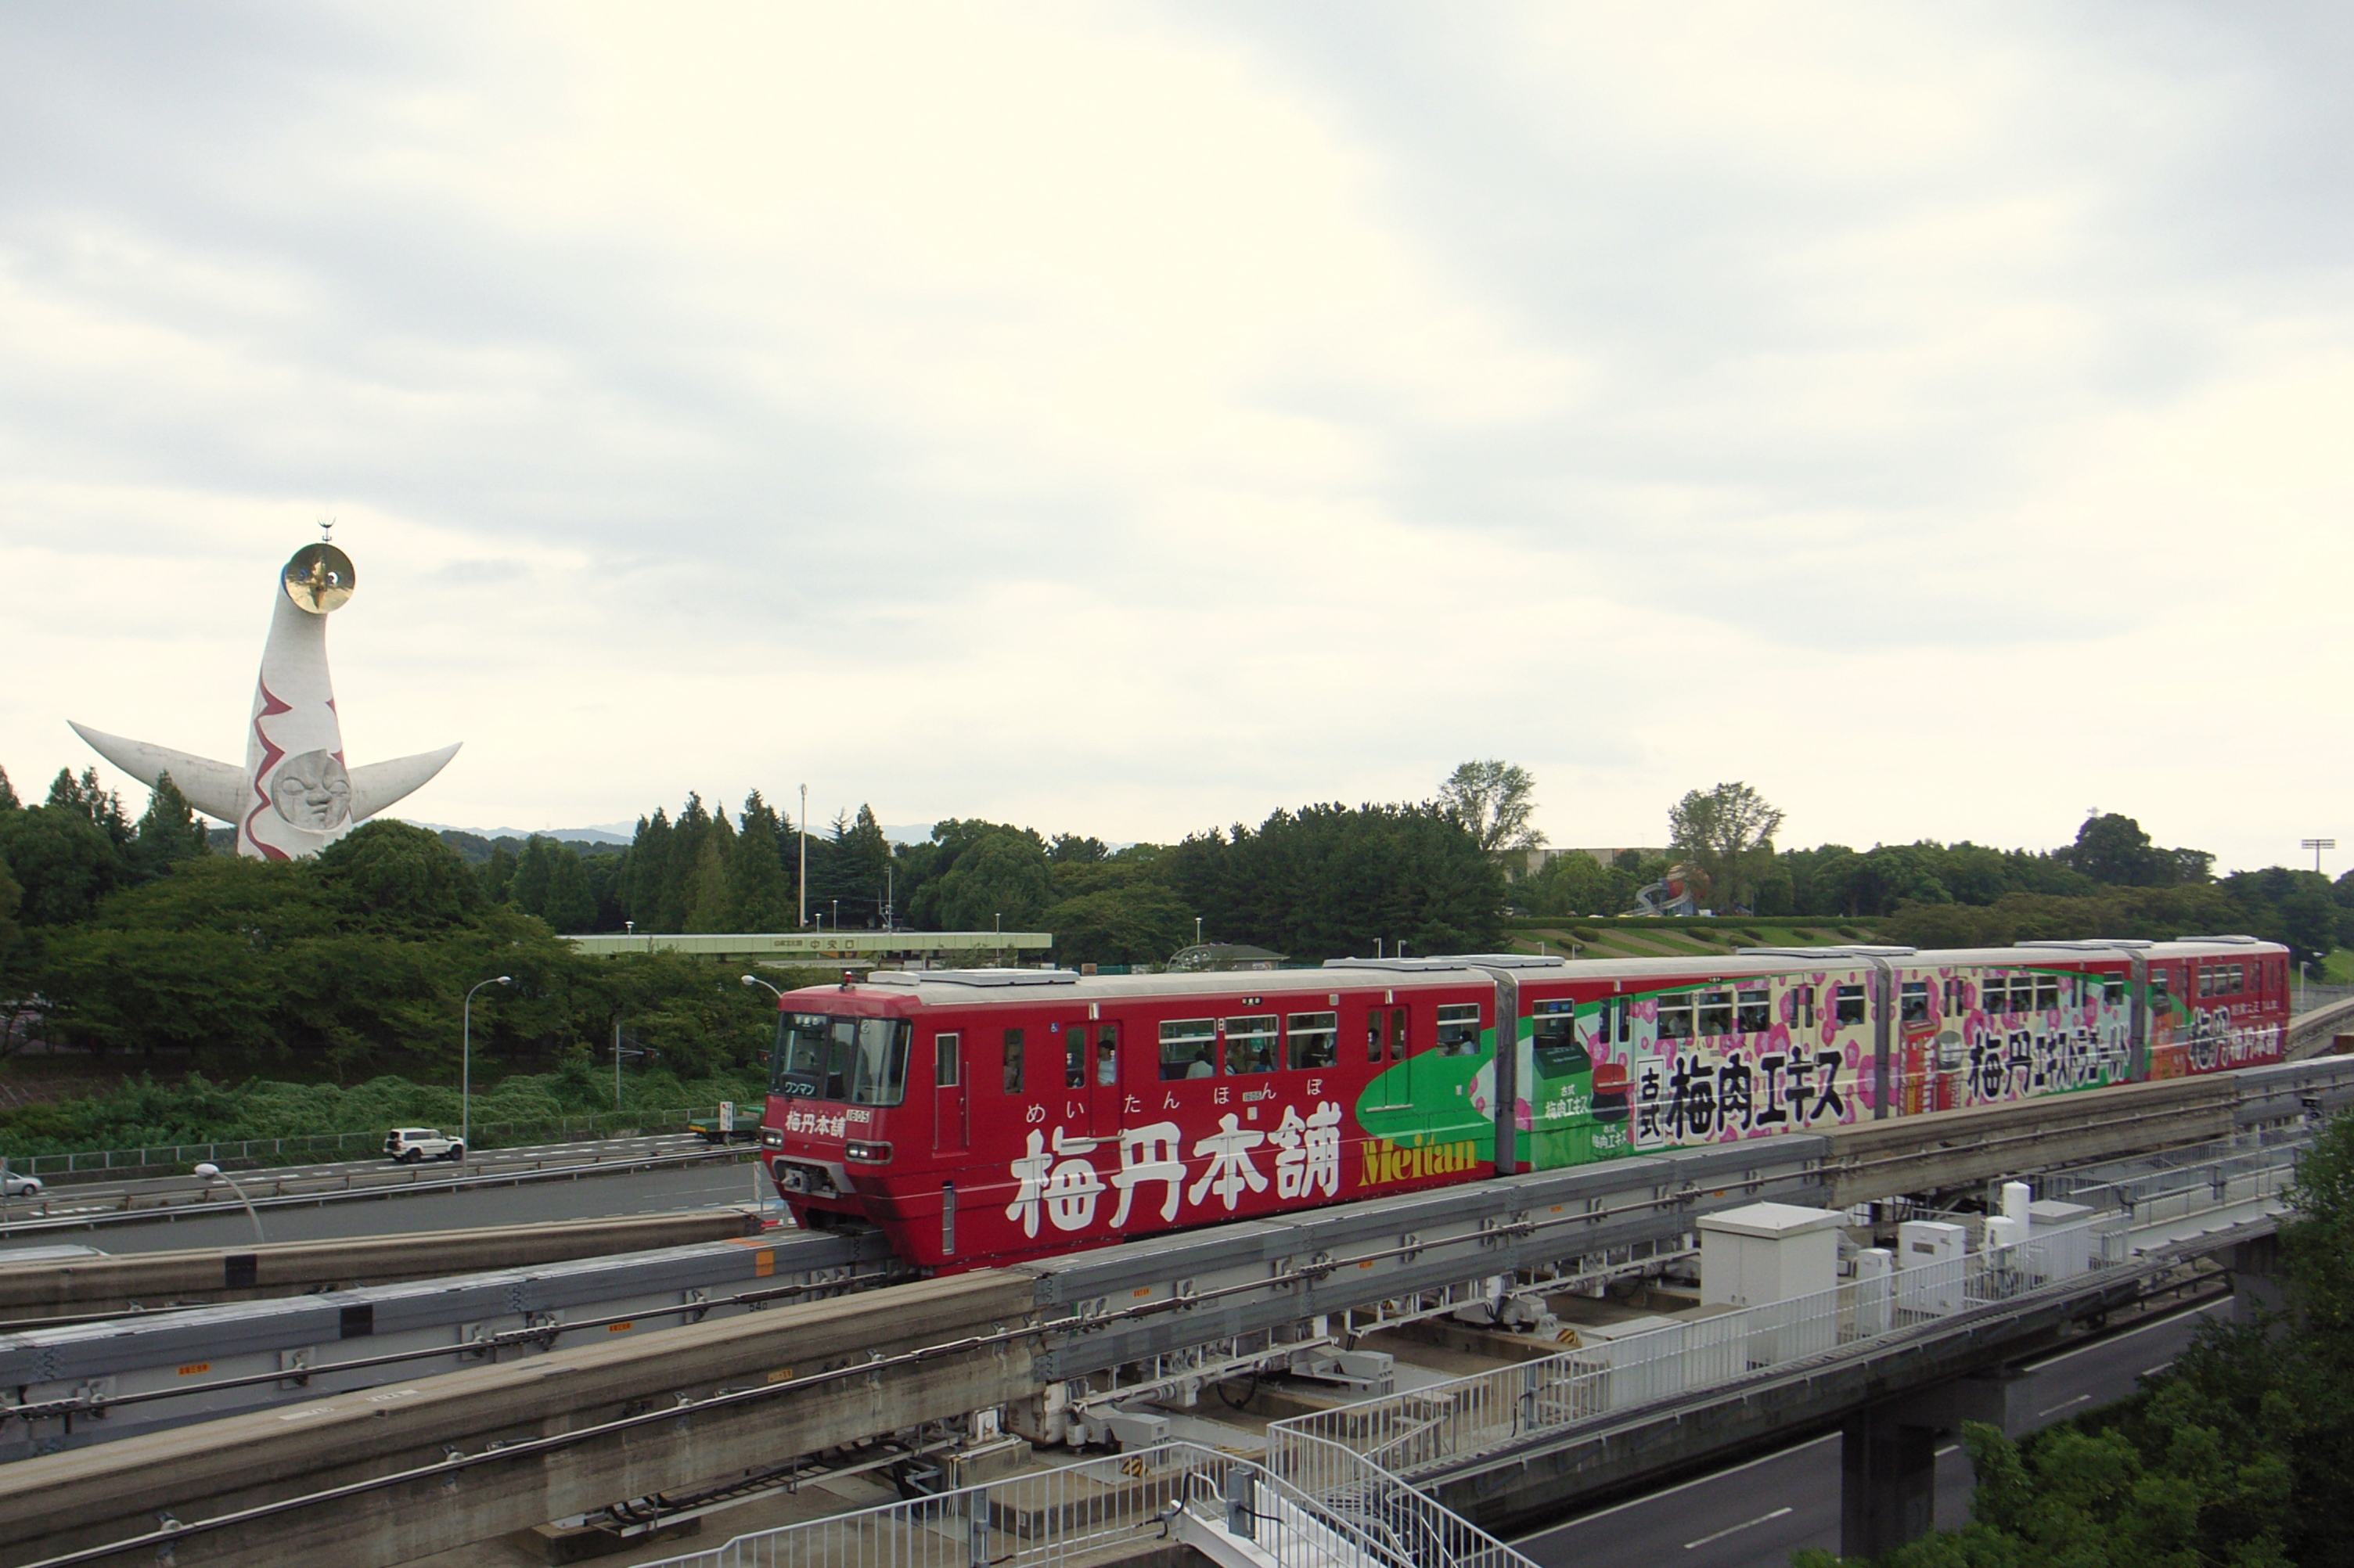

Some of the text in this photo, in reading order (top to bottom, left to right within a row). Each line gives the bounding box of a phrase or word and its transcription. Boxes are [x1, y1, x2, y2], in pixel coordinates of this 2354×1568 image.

[810, 939, 855, 949] 中央口
[785, 1081, 816, 1095] ワンマン
[1640, 1068, 1661, 1139] 古式
[1666, 1045, 1844, 1140] 梅肉エキス
[785, 1109, 847, 1138] 梅丹本舗
[848, 1110, 869, 1122] 1605
[1006, 1100, 1342, 1239] 梅丹本舗
[1357, 1133, 1478, 1187] Meitan
